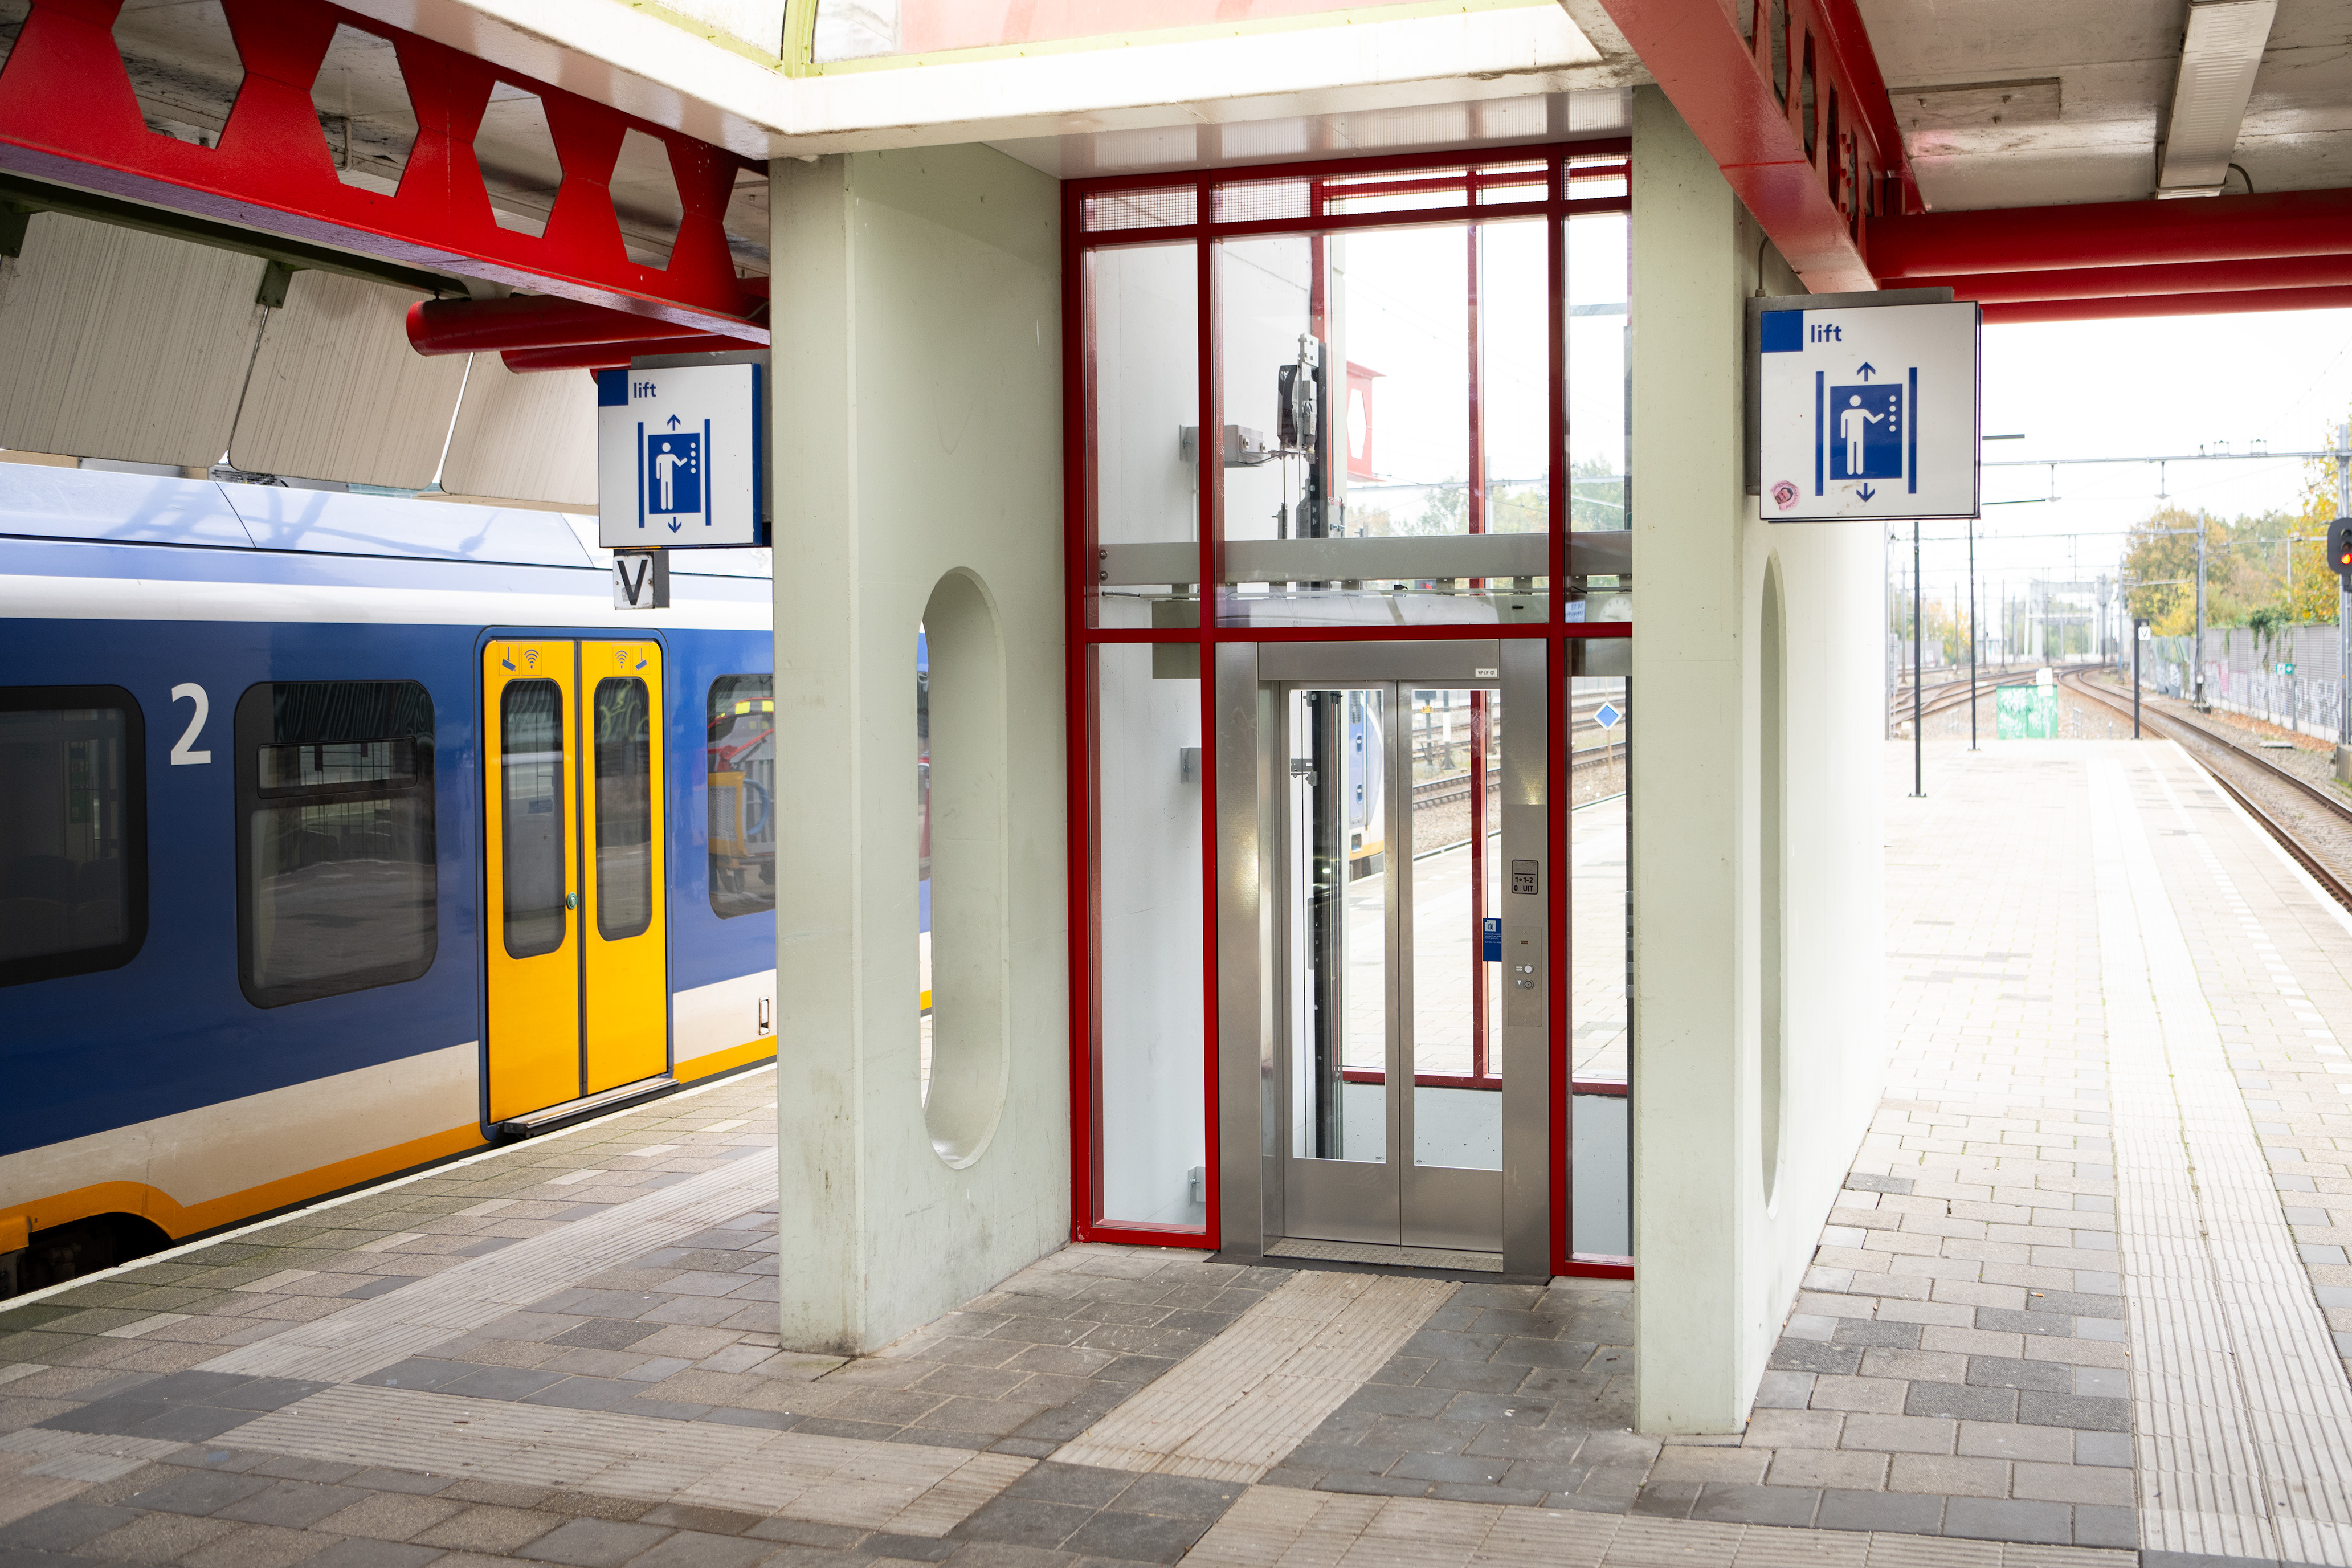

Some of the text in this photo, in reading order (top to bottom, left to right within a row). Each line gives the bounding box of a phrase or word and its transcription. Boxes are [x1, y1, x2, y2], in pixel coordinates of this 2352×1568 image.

[1811, 324, 1842, 343] lift
[634, 382, 656, 398] lift
[617, 559, 648, 606] V
[171, 683, 211, 766] 2
